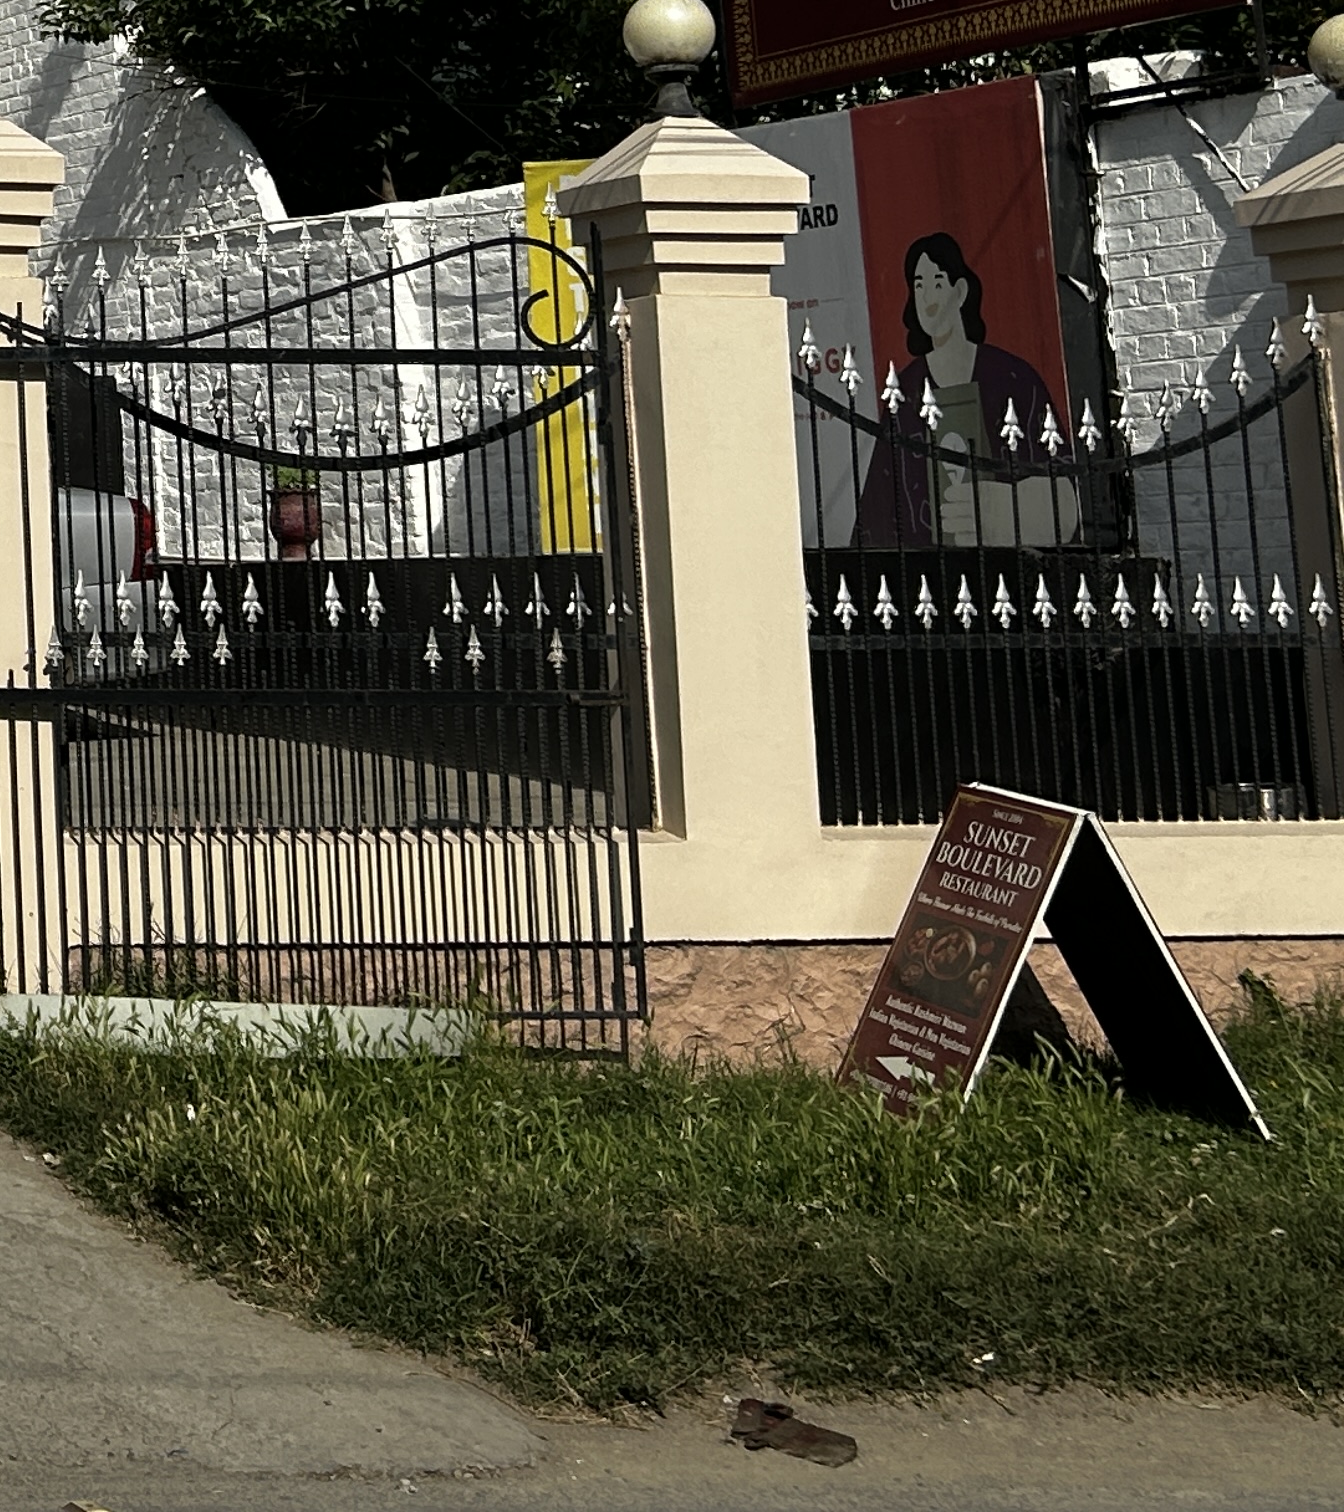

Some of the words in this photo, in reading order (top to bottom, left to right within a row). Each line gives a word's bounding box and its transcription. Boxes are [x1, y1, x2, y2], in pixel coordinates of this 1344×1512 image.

[962, 820, 1036, 858] SUNSET
[935, 841, 1043, 890] BOULEVARD
[939, 871, 1020, 908] RESTAURANT
